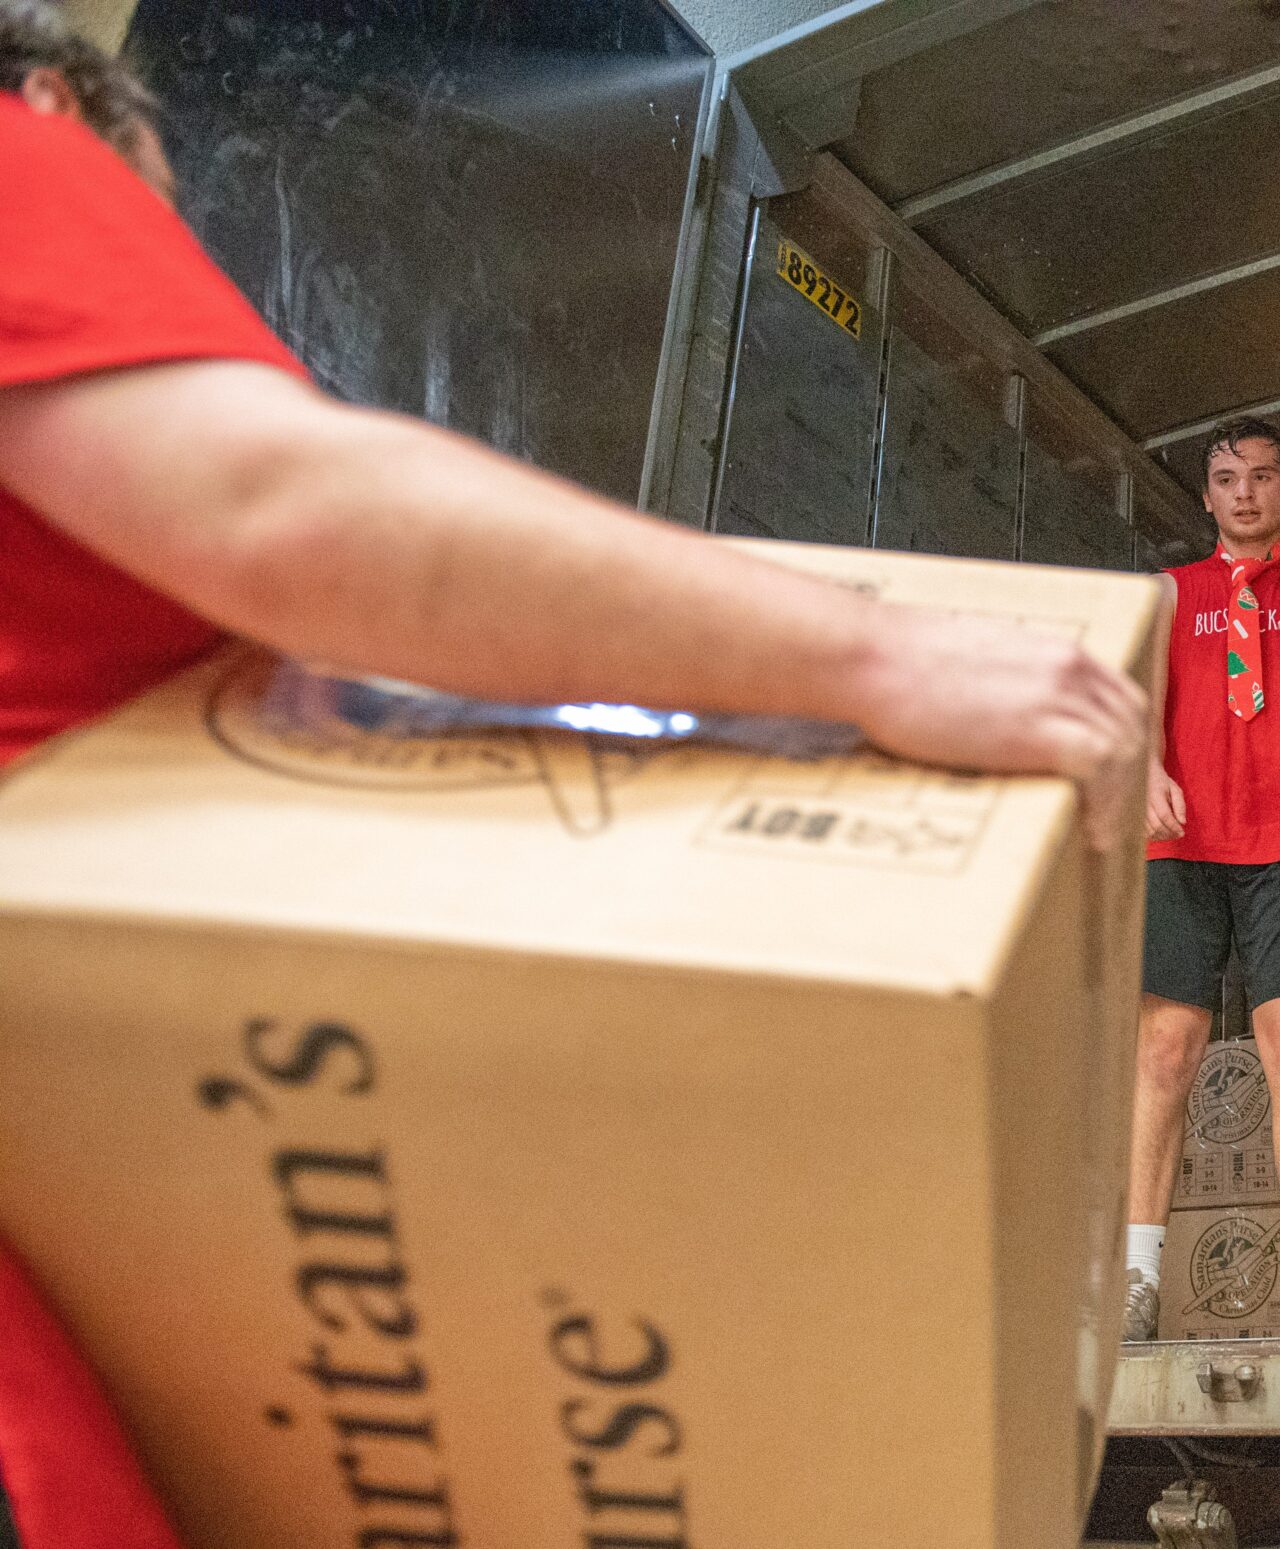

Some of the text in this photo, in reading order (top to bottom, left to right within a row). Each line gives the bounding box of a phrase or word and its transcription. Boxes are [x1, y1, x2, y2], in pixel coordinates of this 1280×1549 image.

[787, 251, 859, 335] 89272
[1195, 608, 1228, 637] BUCS
[724, 802, 841, 841] BOY
[1225, 1052, 1252, 1070] Purse
[1183, 1157, 1193, 1175] BOY
[1233, 1152, 1244, 1172] GIRL
[546, 1312, 689, 1549] rse
